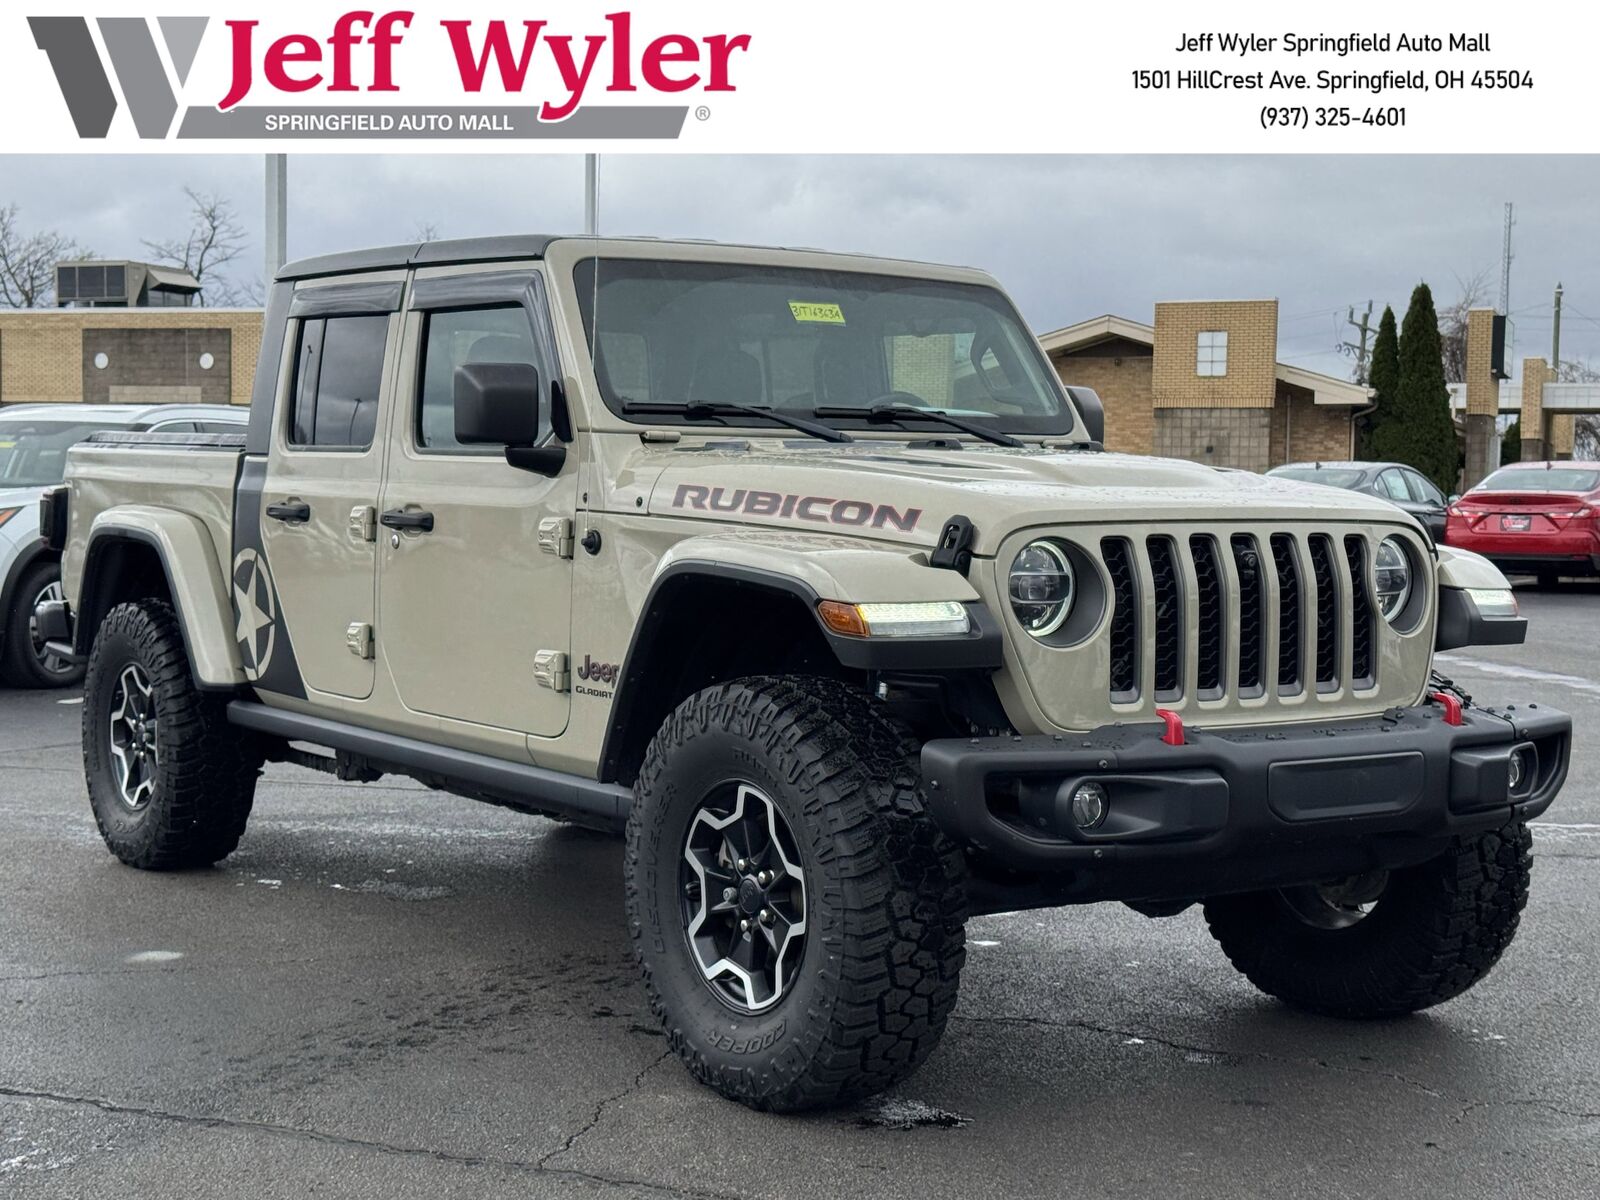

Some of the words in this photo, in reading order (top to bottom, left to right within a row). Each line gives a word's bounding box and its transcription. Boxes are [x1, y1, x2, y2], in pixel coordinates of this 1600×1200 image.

[672, 484, 923, 533] RUBICON
[575, 685, 613, 699] GLADIAT
[704, 1017, 787, 1055] COOPER
